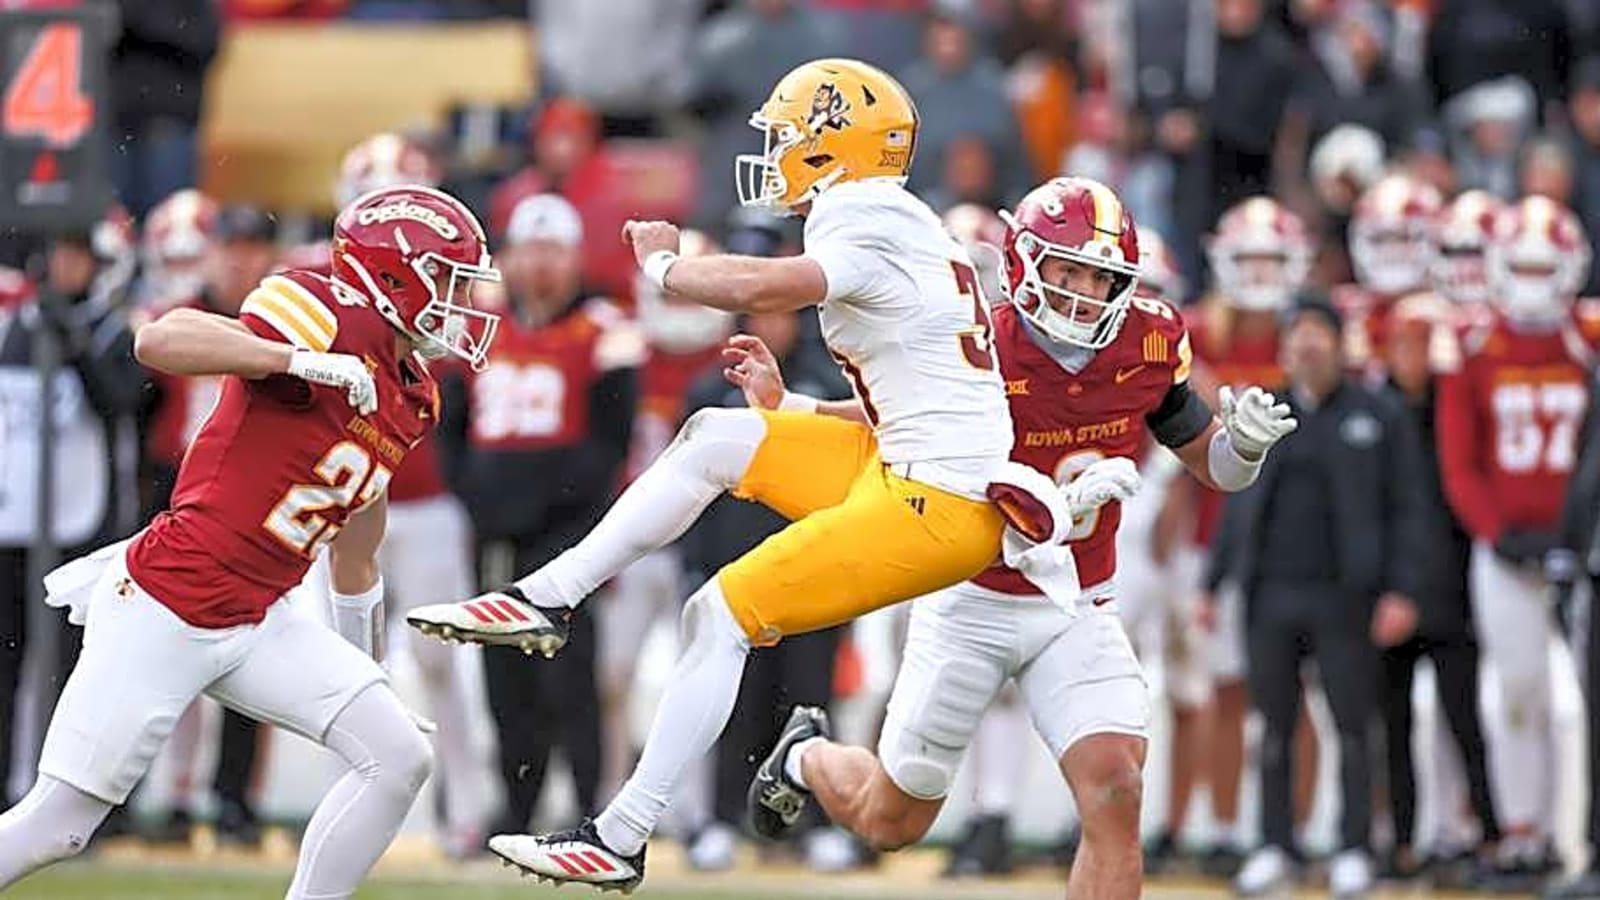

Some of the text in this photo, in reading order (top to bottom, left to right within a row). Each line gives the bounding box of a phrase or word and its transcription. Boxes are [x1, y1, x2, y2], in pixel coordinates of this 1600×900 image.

[4, 22, 95, 146] 4
[359, 201, 458, 240] Cyclones
[1025, 416, 1129, 446] IOWA STATE
